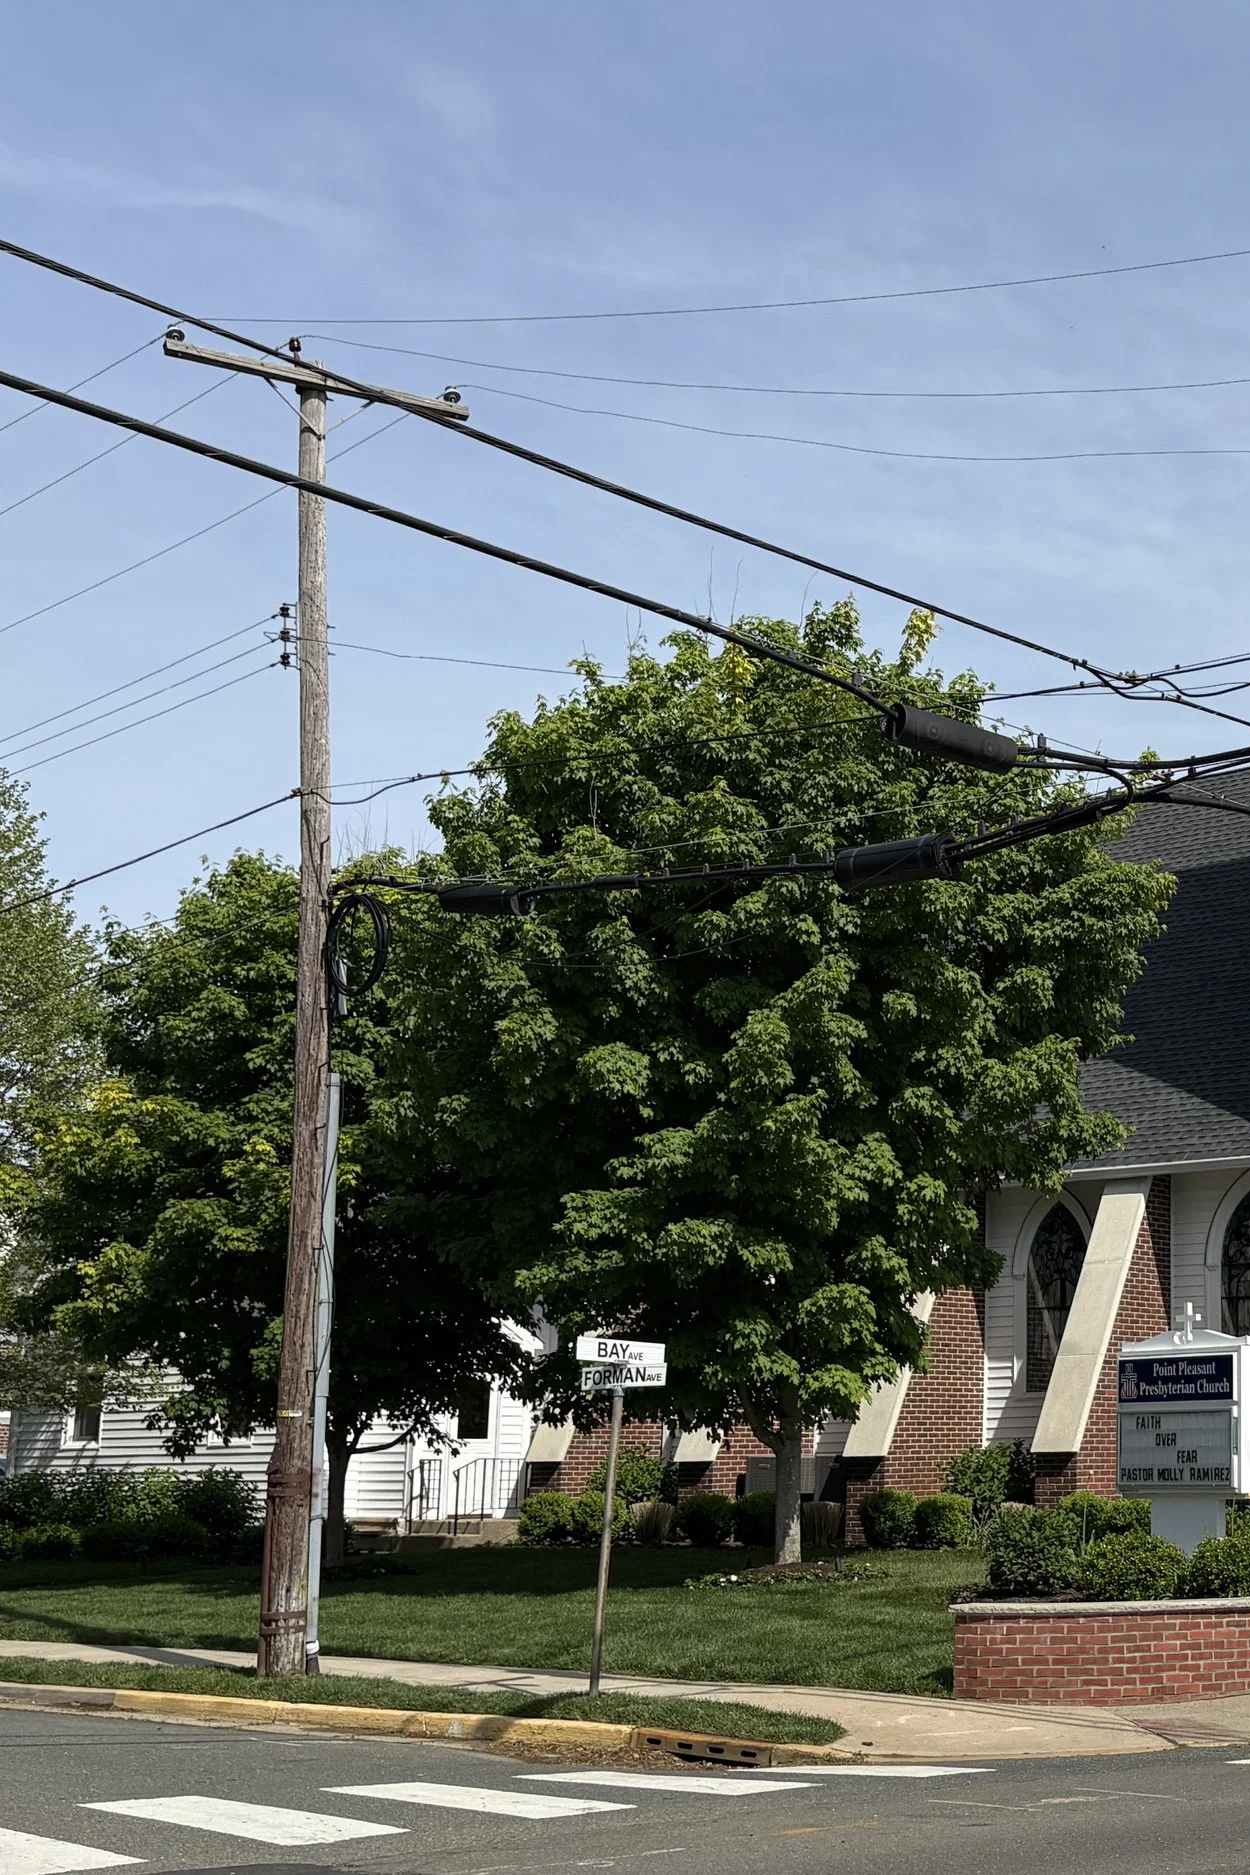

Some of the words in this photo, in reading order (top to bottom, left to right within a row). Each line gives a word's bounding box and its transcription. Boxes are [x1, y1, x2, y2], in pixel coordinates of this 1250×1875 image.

[598, 1342, 630, 1359] BAY
[628, 1352, 644, 1361] AVE
[584, 1367, 646, 1386] FORMAN
[646, 1373, 662, 1381] AVE
[1153, 1362, 1177, 1377] Point
[1178, 1361, 1216, 1375] Pleasant
[1139, 1380, 1195, 1398] Presbyterian
[1197, 1378, 1230, 1394] Church
[1136, 1416, 1161, 1430] FAITH
[1155, 1433, 1177, 1447] OVER
[1177, 1450, 1198, 1464] FEAR
[1121, 1468, 1154, 1482] PASTOR
[1158, 1468, 1183, 1481] MOLLY
[1190, 1467, 1230, 1481] RAMIREZ
